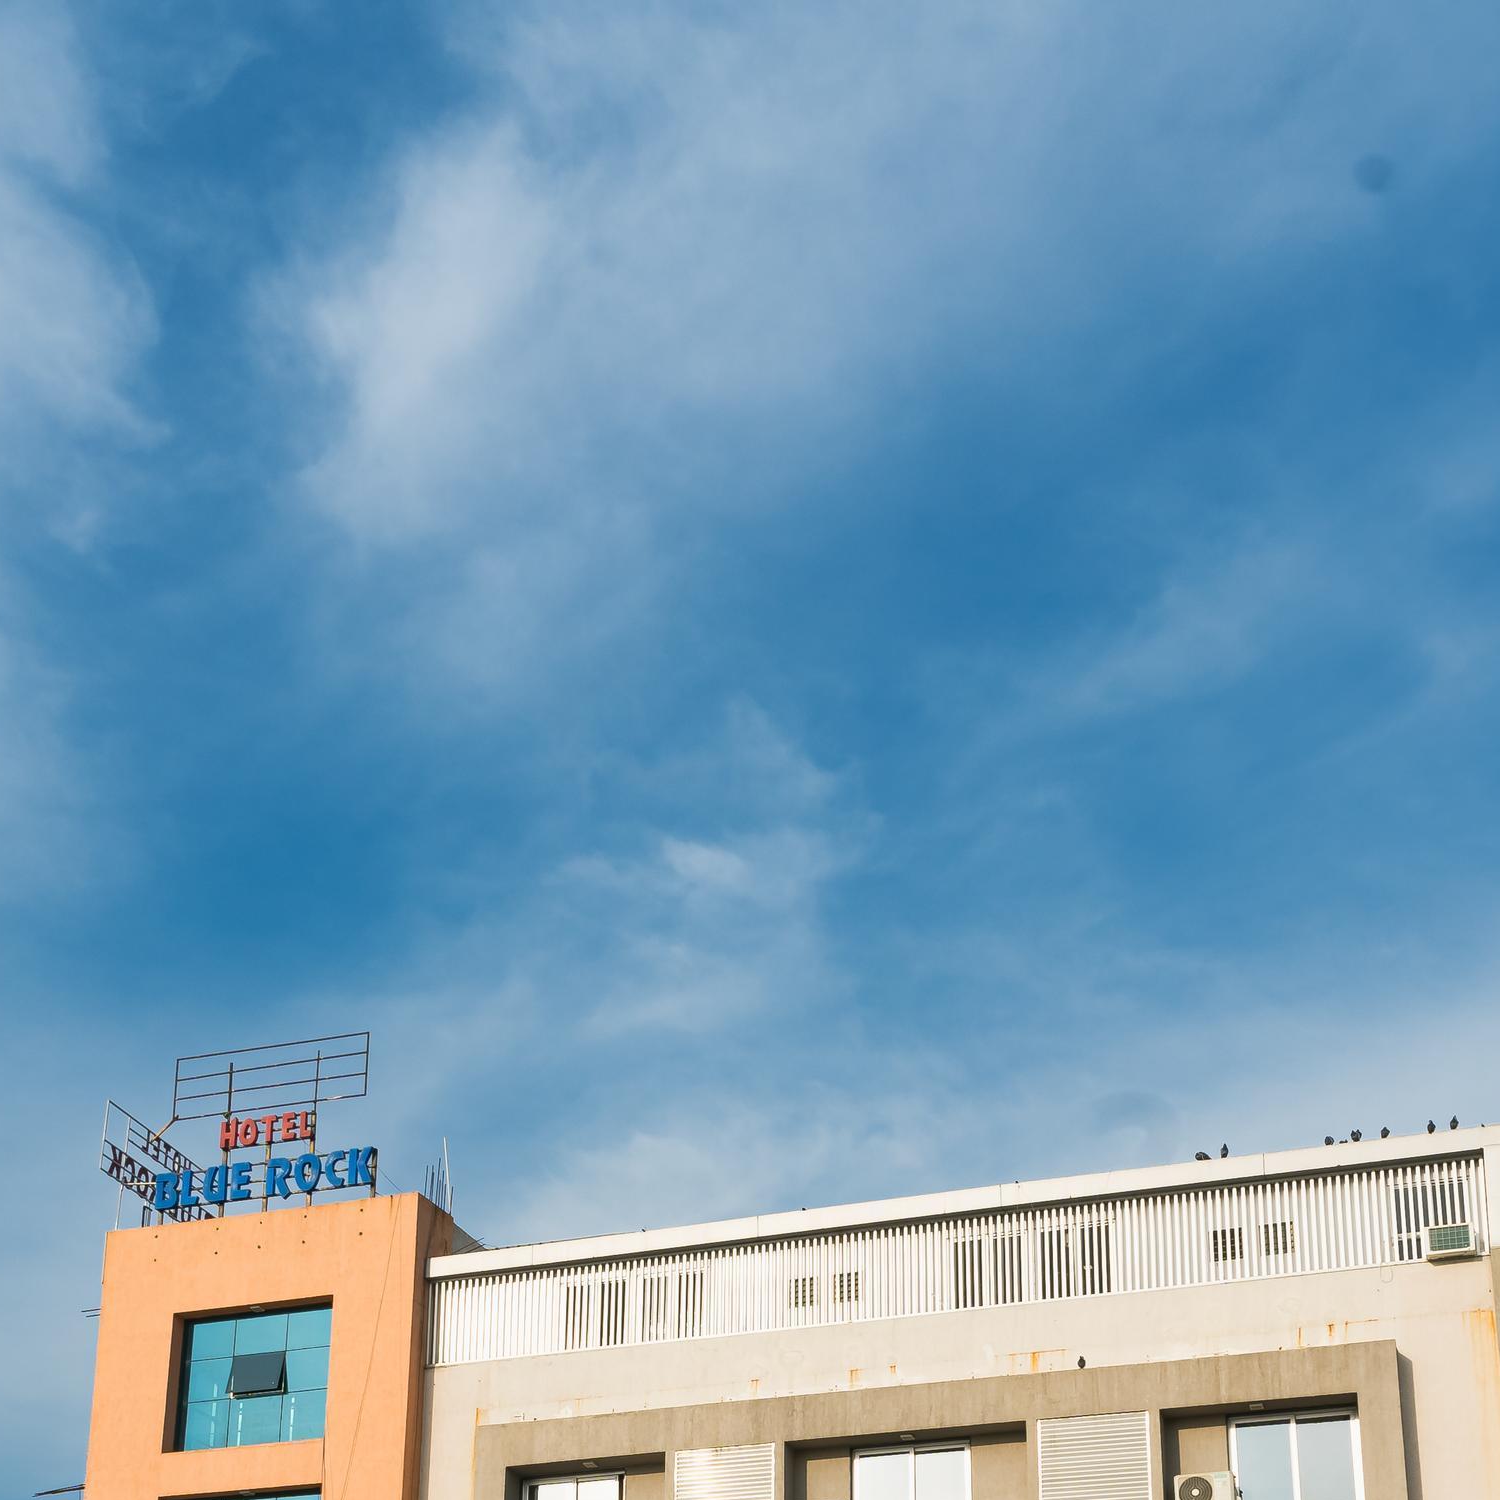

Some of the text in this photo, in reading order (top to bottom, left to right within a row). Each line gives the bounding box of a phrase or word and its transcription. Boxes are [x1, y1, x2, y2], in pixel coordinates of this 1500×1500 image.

[220, 1111, 315, 1151] HOTEL
[154, 1146, 379, 1211] BLUE ROCK
